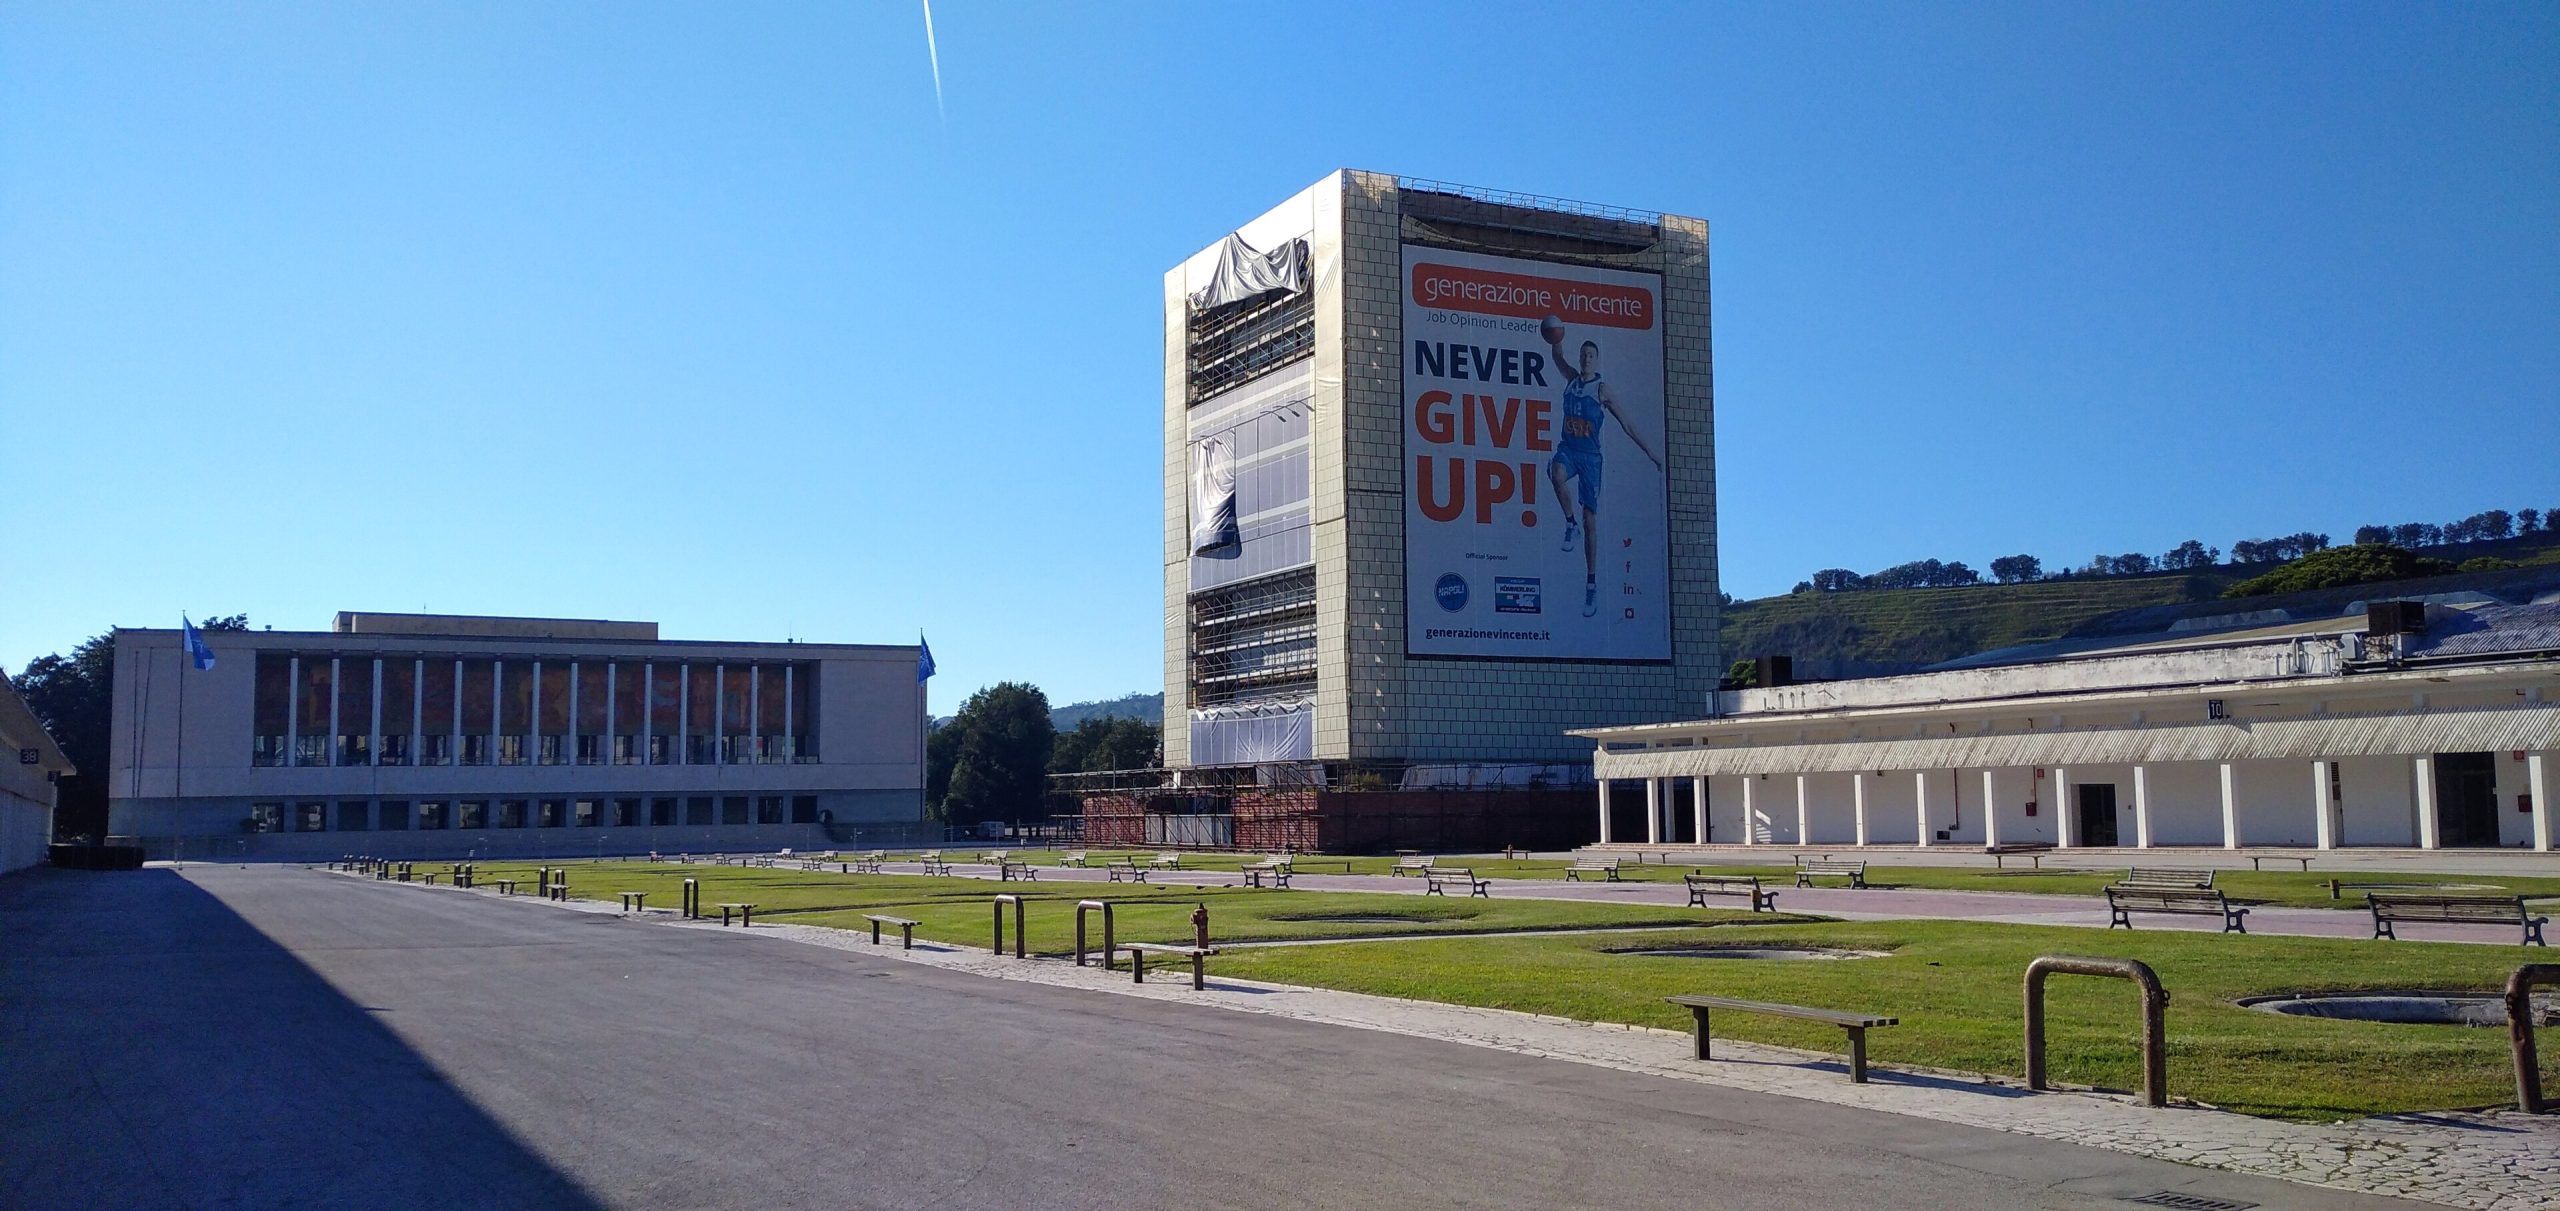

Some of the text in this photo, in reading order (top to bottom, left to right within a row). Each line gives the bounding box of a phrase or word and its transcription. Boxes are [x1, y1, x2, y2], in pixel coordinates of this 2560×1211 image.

[1424, 277, 1642, 317] generazione vincente
[1426, 311, 1539, 333] Job Opinion Leader
[1415, 340, 1547, 387] NEVER
[1414, 389, 1552, 451] GIVE
[1417, 455, 1538, 528] UP!
[1465, 552, 1485, 560] Official
[1425, 627, 1551, 640] generazionevincente.it
[2211, 703, 2222, 716] 10
[22, 751, 37, 762] 38
